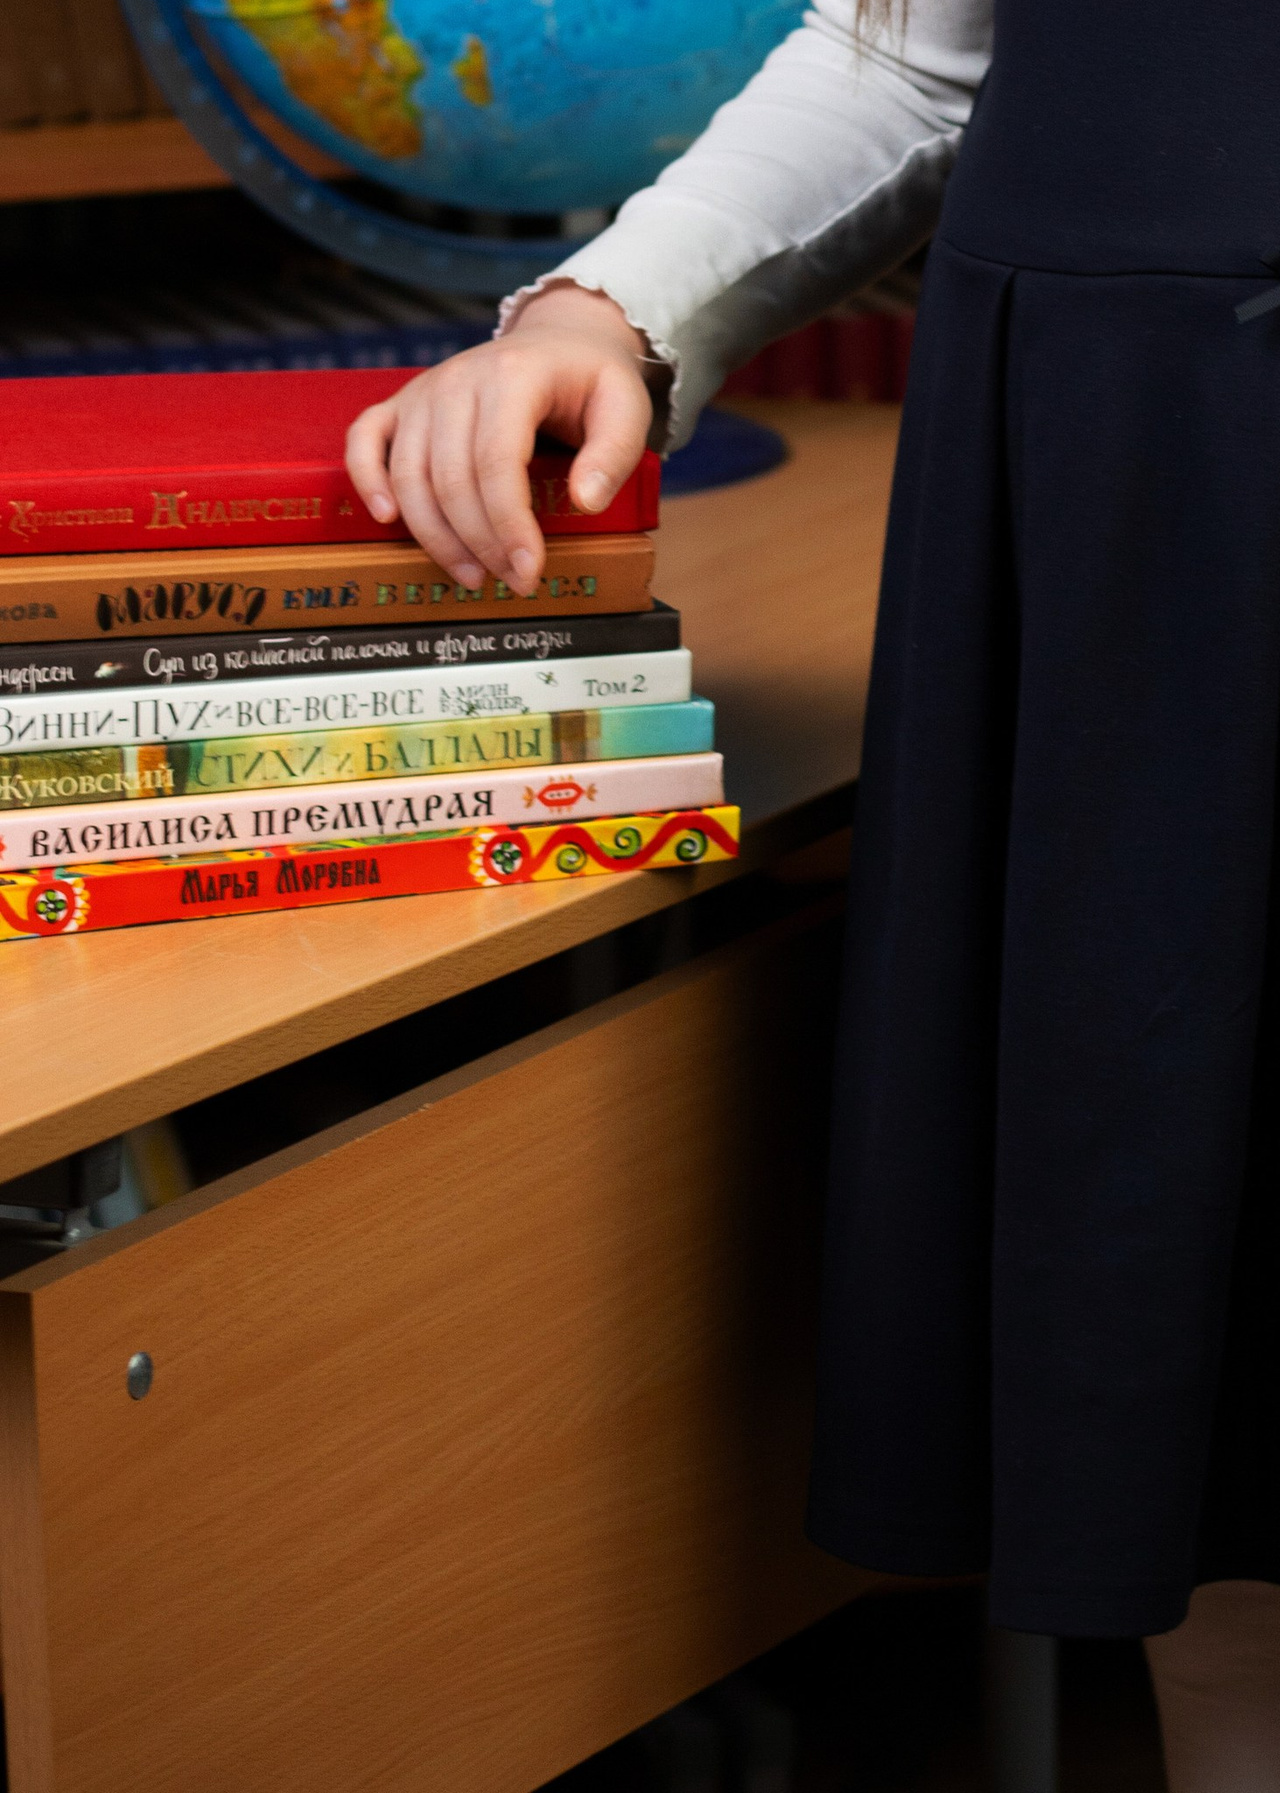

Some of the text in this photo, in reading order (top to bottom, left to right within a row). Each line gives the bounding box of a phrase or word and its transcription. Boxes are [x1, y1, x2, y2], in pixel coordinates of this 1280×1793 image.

[143, 648, 187, 685] Суп
[192, 651, 219, 680] из
[331, 641, 411, 661] палочки
[416, 640, 430, 654] и
[434, 633, 497, 663] другие
[503, 630, 573, 659] сказки
[632, 674, 646, 693] 2
[194, 746, 325, 787] СТИХИ
[364, 728, 542, 772] БАЛЛАДЫ
[30, 790, 496, 857] ВАСИЛИСА ПРЕМУДРАЯ
